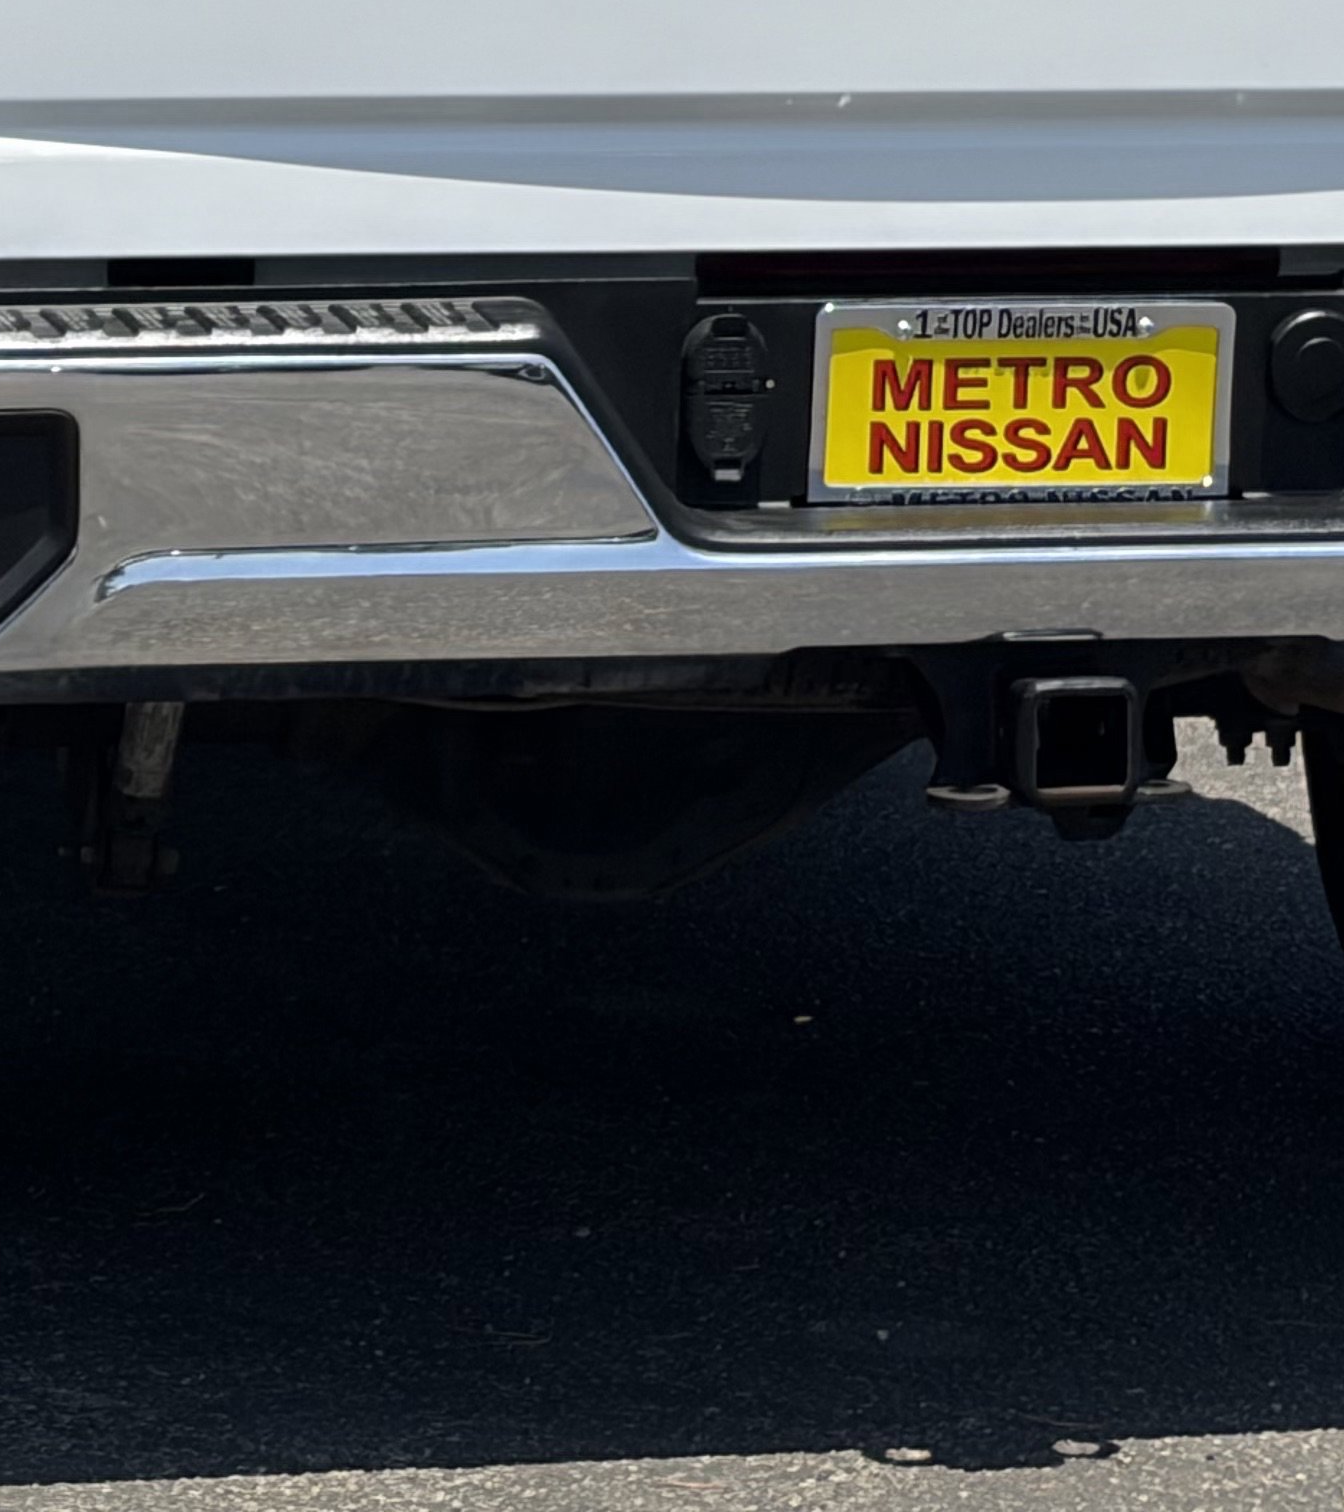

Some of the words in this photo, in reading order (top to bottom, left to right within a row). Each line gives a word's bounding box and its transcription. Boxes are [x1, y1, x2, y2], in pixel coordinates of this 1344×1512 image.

[913, 310, 933, 338] 1
[950, 309, 992, 338] TOP
[998, 308, 1074, 338] Dealers
[1092, 308, 1137, 337] USA
[871, 355, 1172, 411] METRO
[868, 417, 1168, 474] NISSAN
